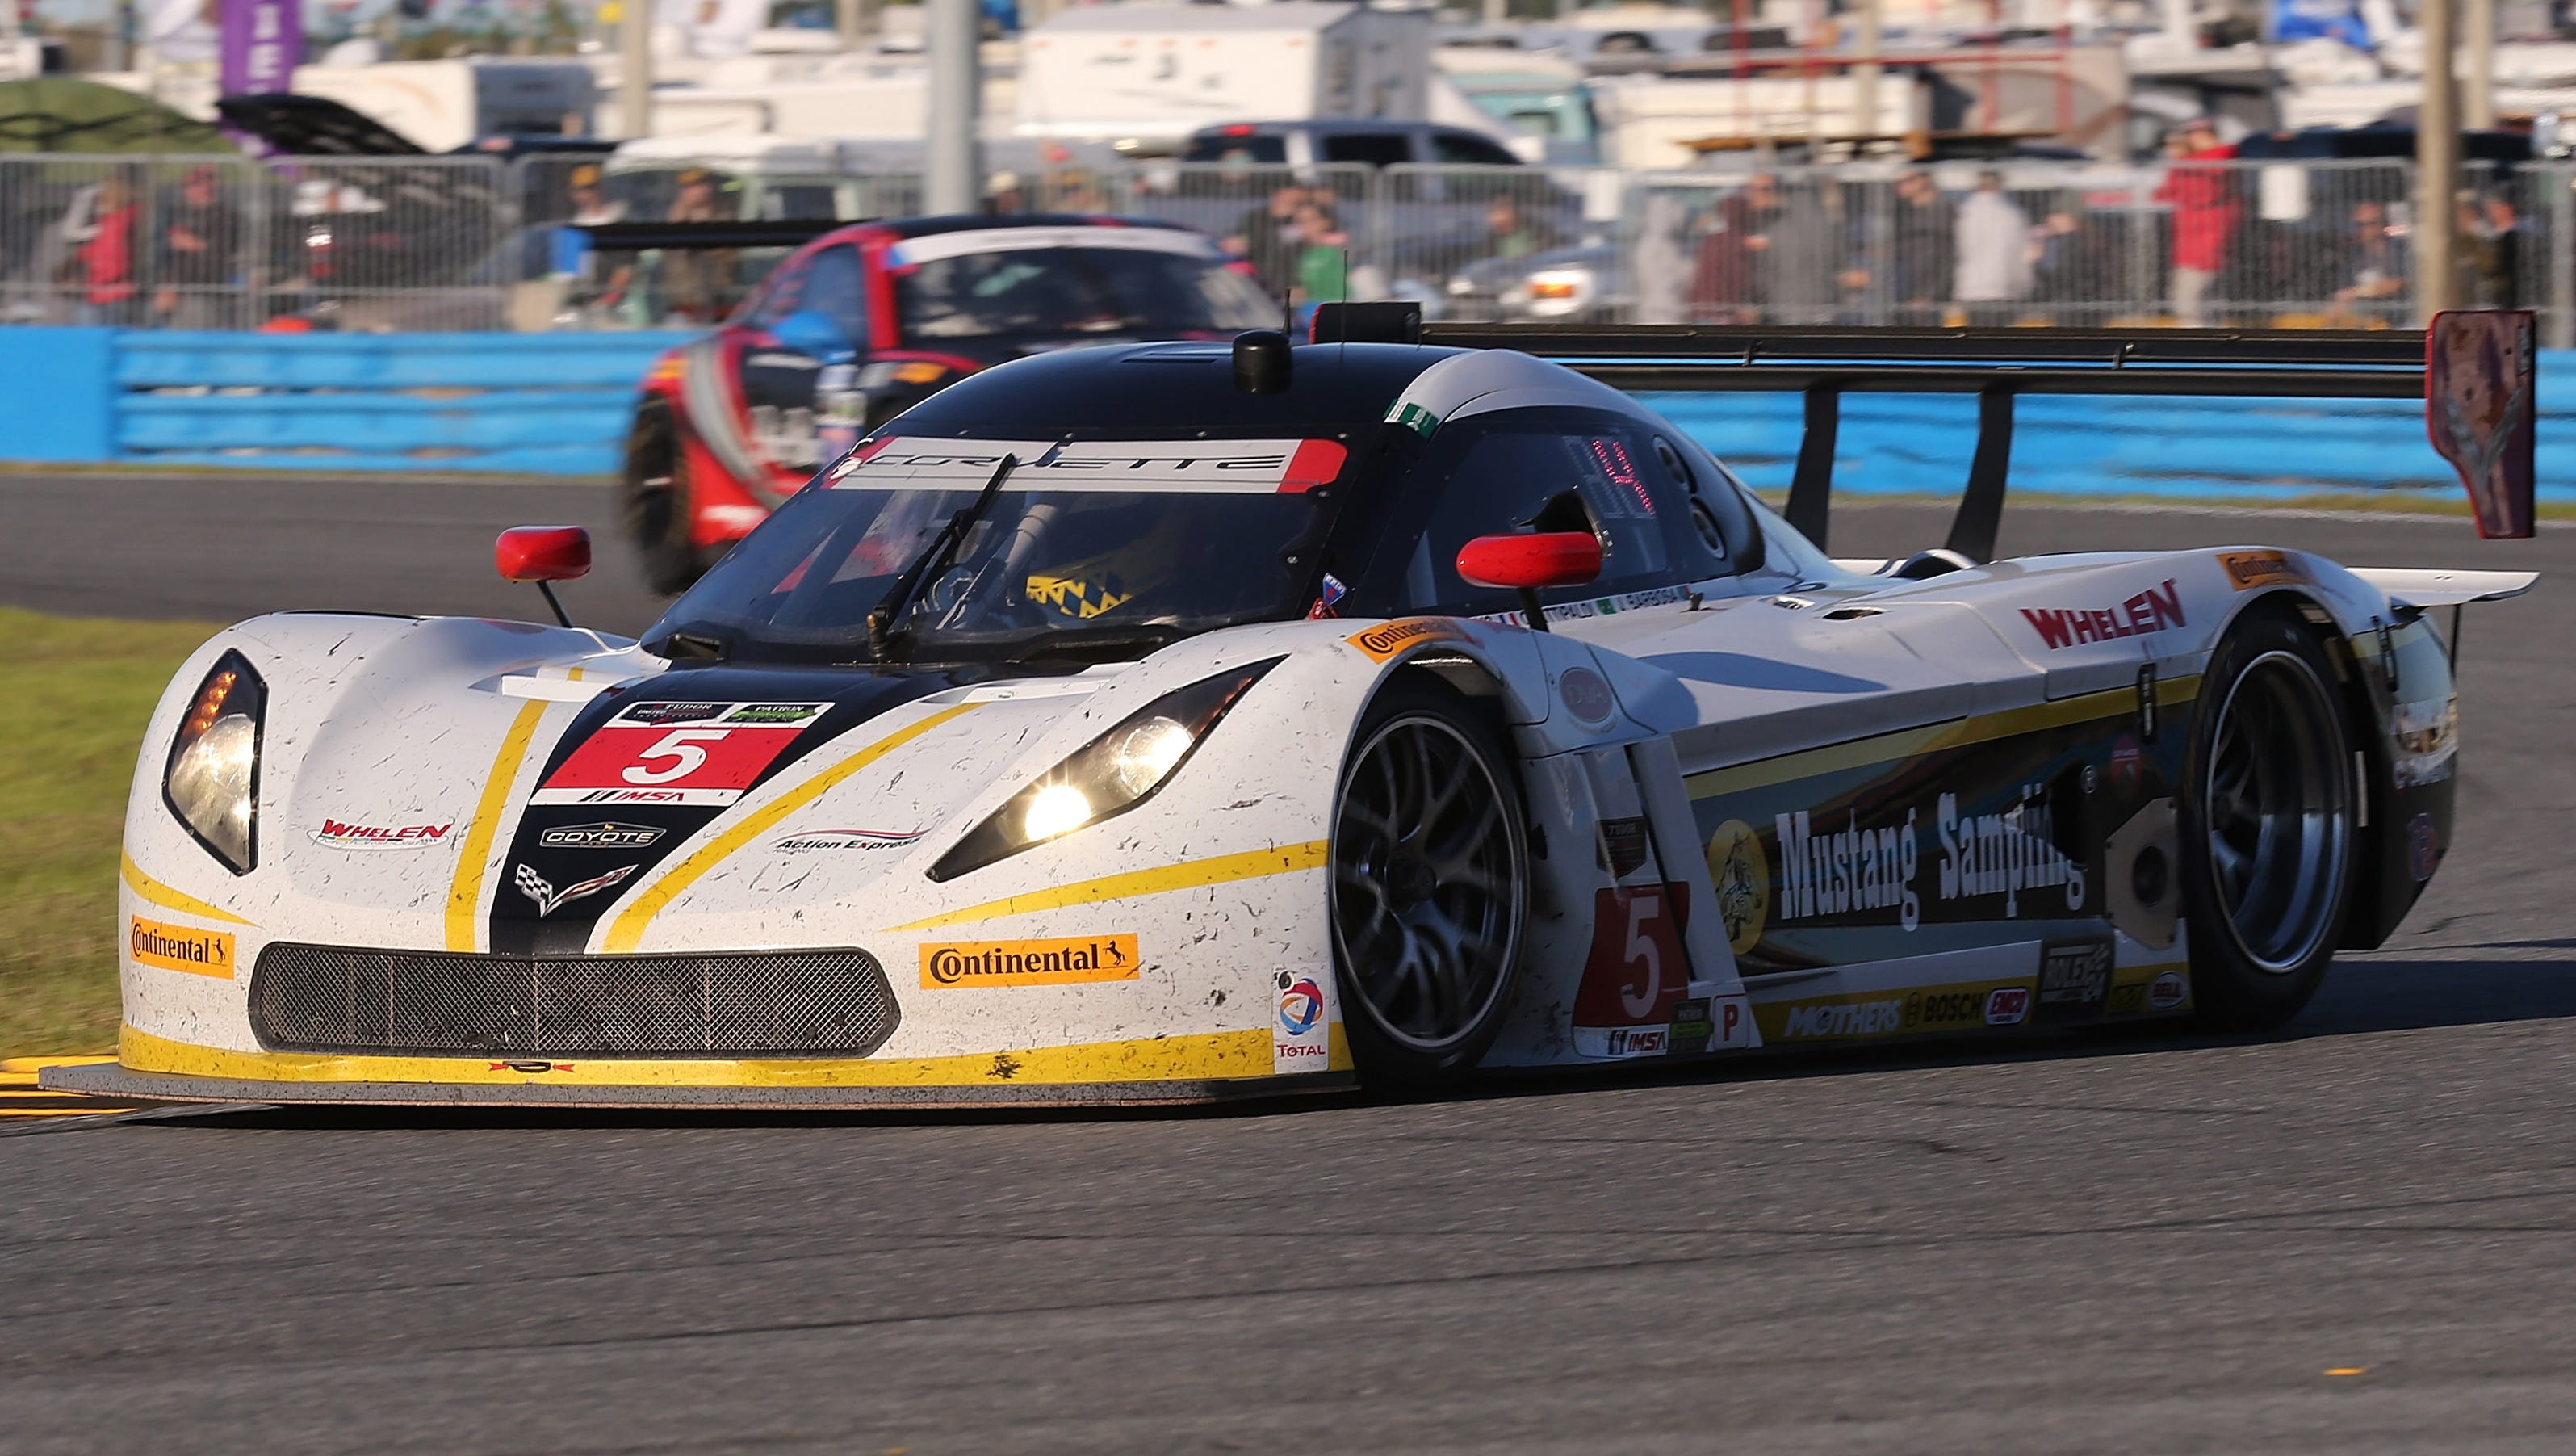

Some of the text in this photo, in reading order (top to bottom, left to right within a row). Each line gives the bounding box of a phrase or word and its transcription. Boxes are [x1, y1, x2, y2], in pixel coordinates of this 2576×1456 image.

[2020, 579, 2185, 649] WHELEN
[621, 729, 731, 785] 5
[611, 791, 684, 801] IMSA
[322, 819, 453, 838] WHELEN
[547, 831, 654, 843] COYOTE
[777, 836, 924, 851] Action Express
[1776, 807, 1920, 932] Mustang
[132, 923, 210, 963] Continental
[1620, 896, 1661, 1019] 5
[929, 943, 1100, 984] Continental
[1724, 1004, 1740, 1042] P
[1784, 1000, 1902, 1038] MOTHERS
[1923, 992, 1984, 1022] BOSCH
[1277, 1043, 1326, 1059] TOTAL
[1627, 1031, 1666, 1053] IMSA
